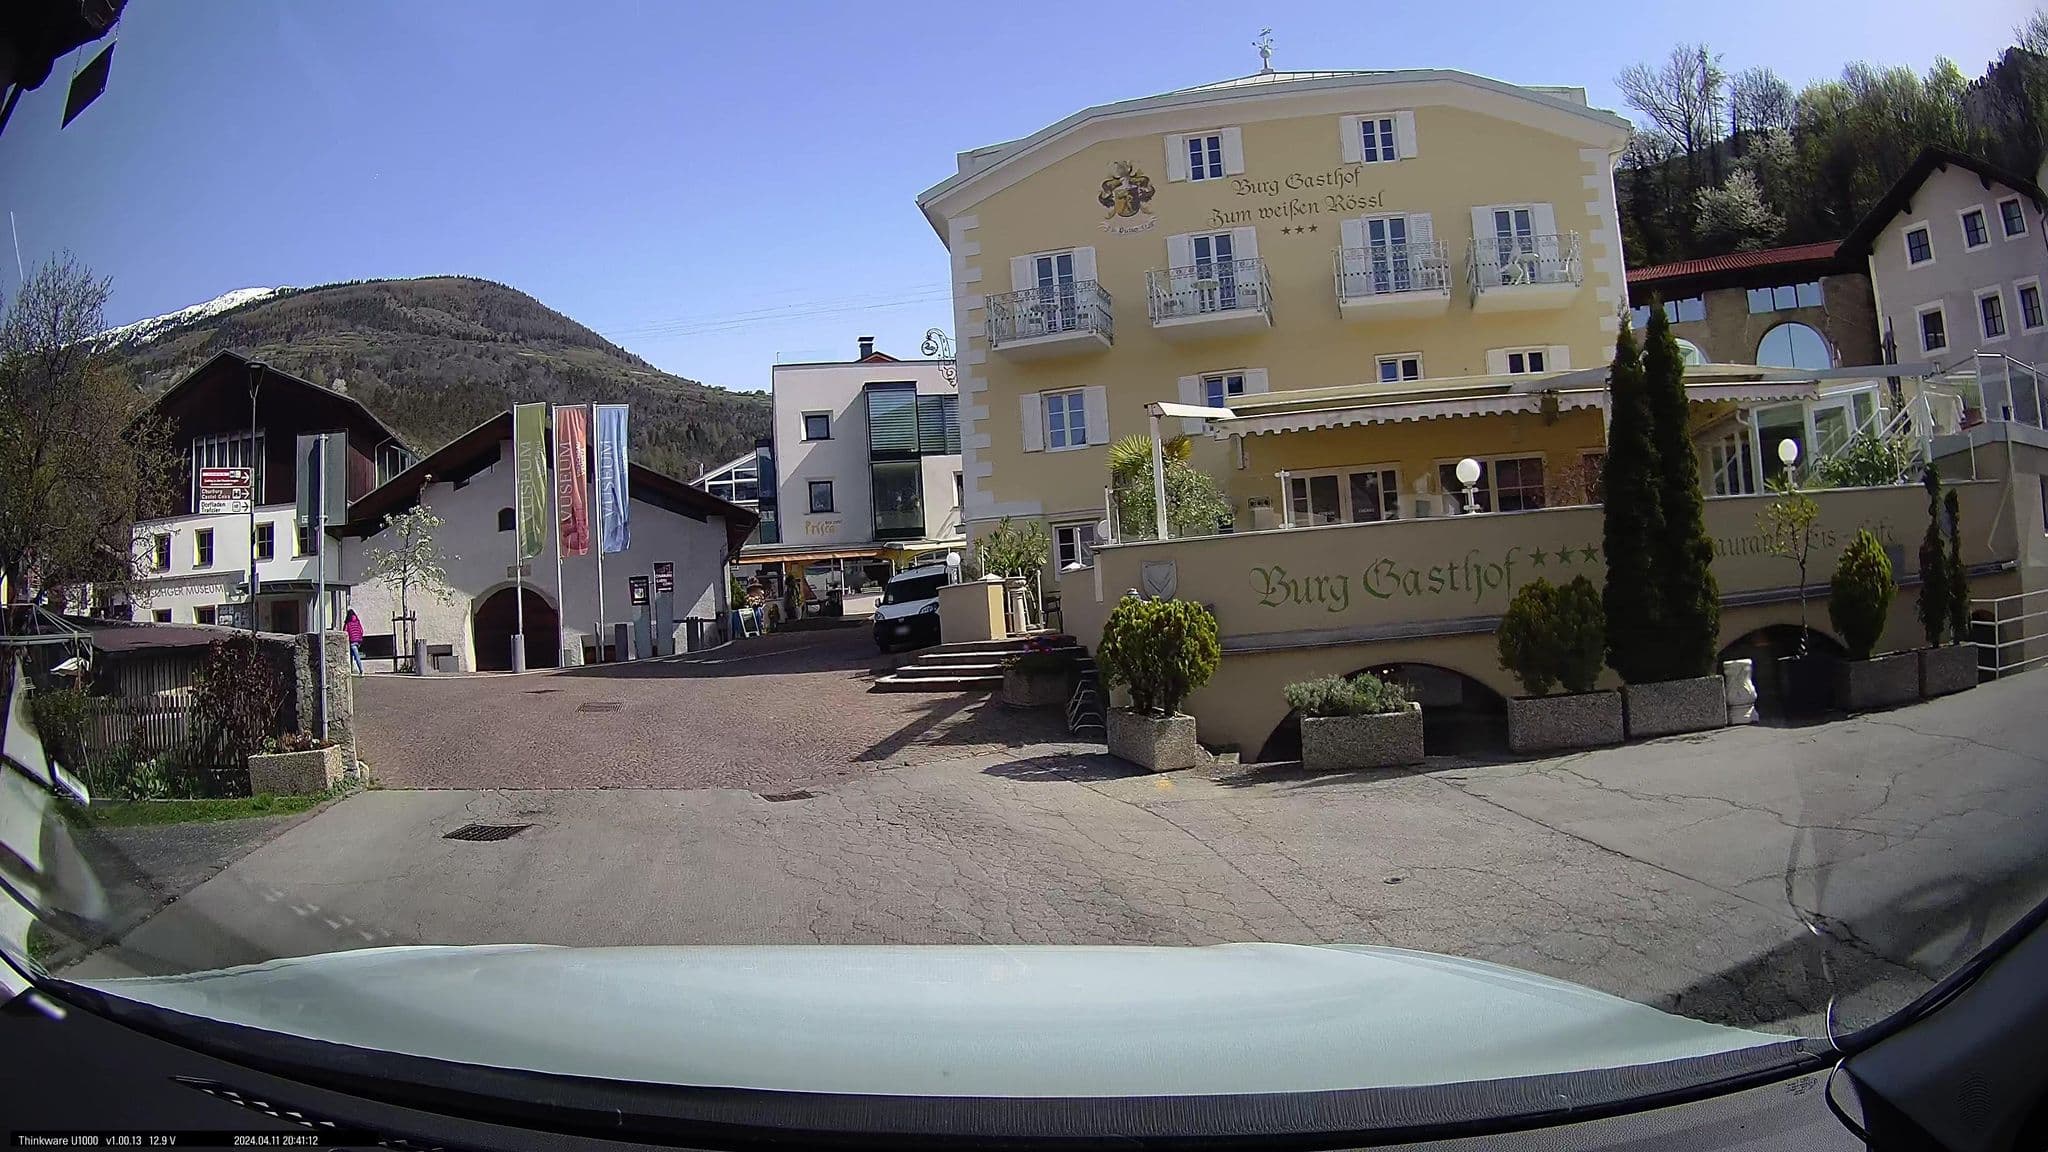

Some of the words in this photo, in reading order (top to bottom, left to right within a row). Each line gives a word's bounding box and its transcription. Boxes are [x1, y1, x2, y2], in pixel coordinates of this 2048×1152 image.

[1231, 178, 1279, 197] Burg
[1285, 165, 1364, 190] Gasthof
[1207, 208, 1252, 229] Zum
[1259, 199, 1320, 221] weißen
[1325, 190, 1386, 213] Rössl
[186, 584, 224, 596] MUSEUM
[1250, 565, 1350, 613] Burg
[1363, 546, 1521, 604] Gasthof
